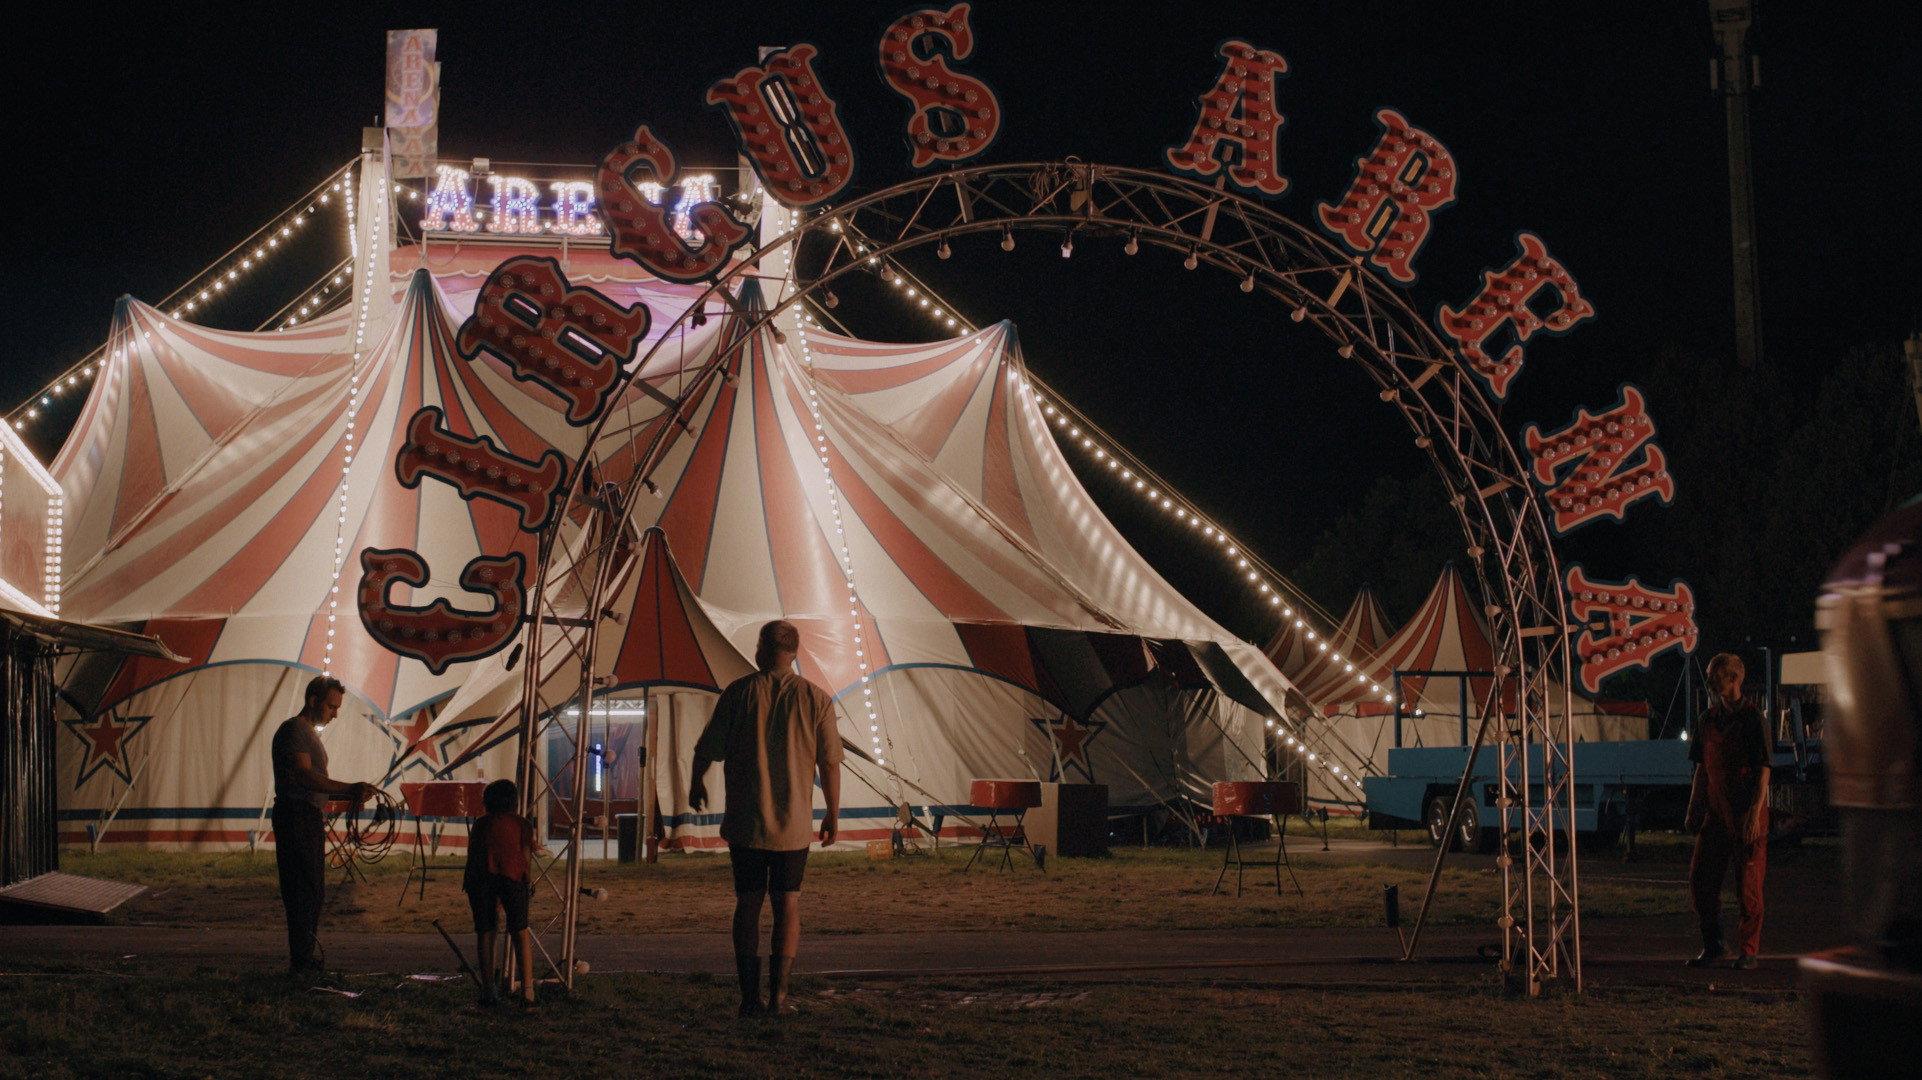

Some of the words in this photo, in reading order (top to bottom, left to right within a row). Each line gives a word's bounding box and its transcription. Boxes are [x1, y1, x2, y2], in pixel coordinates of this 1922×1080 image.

[358, 2, 1001, 674] CIRCUS
[1165, 38, 1699, 694] ARENA
[420, 164, 716, 242] AREA
